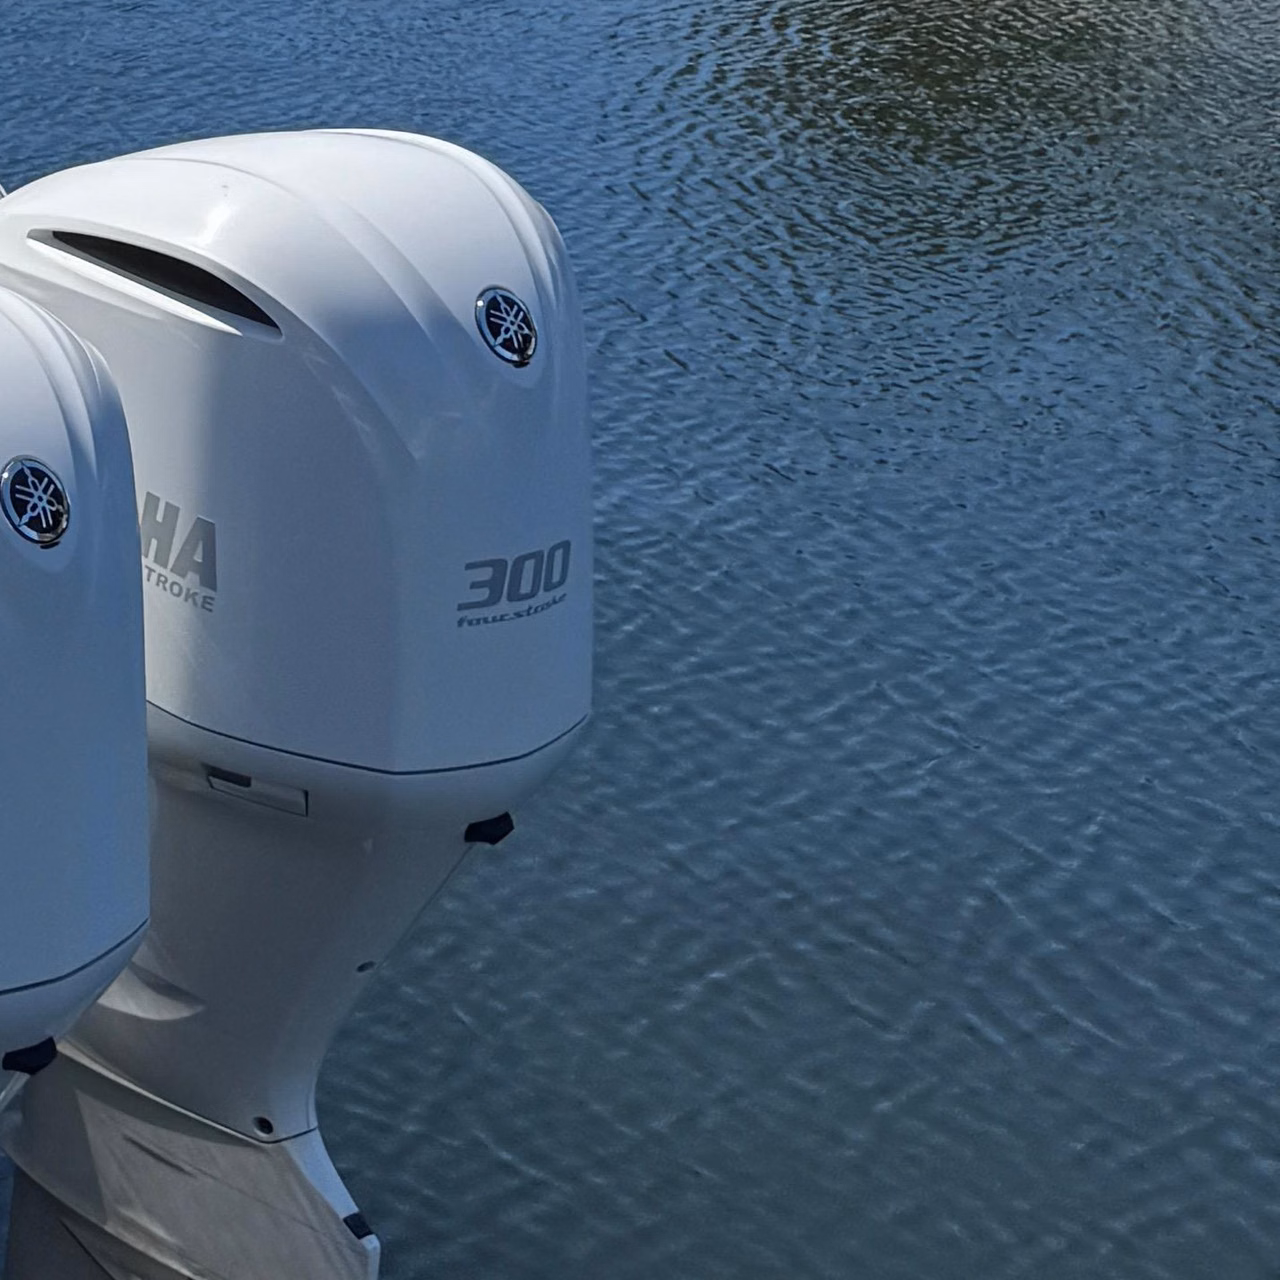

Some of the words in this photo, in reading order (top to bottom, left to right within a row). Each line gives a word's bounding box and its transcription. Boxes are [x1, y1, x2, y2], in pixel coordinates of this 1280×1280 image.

[140, 490, 217, 593] HA
[457, 539, 571, 611] 300
[144, 564, 215, 613] TROKE
